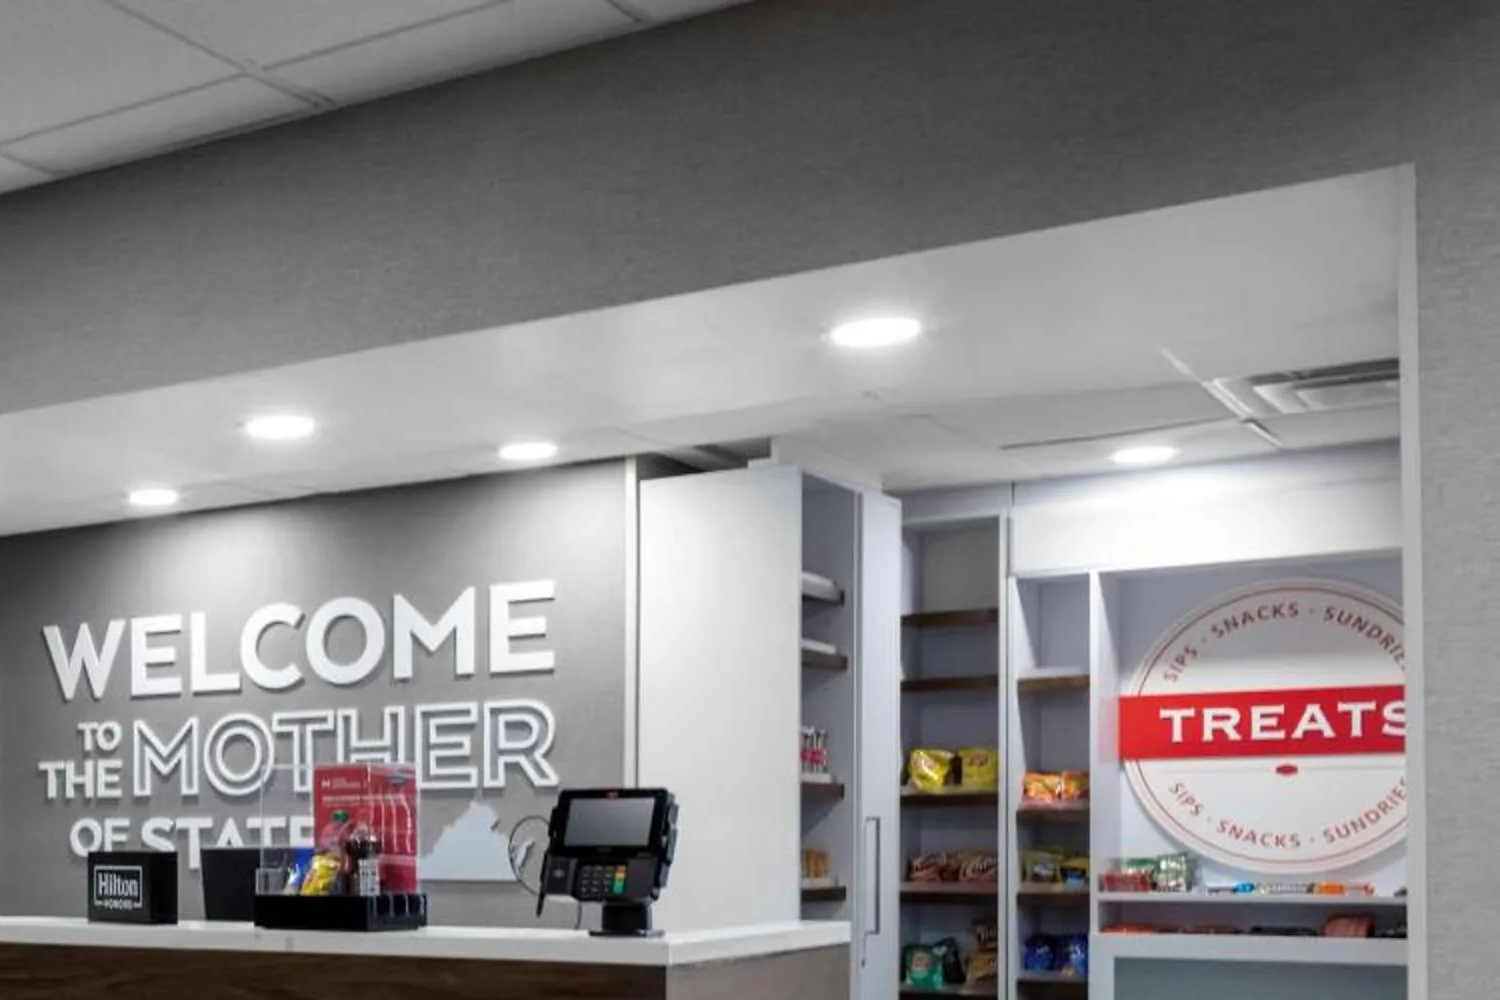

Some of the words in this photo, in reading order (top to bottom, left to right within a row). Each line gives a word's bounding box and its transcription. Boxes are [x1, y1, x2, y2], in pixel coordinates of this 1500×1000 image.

[43, 579, 556, 701] WELCOME
[1163, 646, 1198, 683] SIPS
[1211, 601, 1300, 638] SNACKS
[1323, 605, 1407, 672] SUNDRIE
[77, 720, 122, 752] TO
[1159, 700, 1408, 744] TREATS
[133, 699, 561, 799] MOTHER
[39, 759, 122, 799] THE
[1169, 781, 1203, 818] SIPS
[1216, 819, 1302, 849] SNACKS
[1323, 779, 1408, 844] SUNDRIE
[69, 816, 131, 859] OF
[98, 872, 139, 897] Hilton
